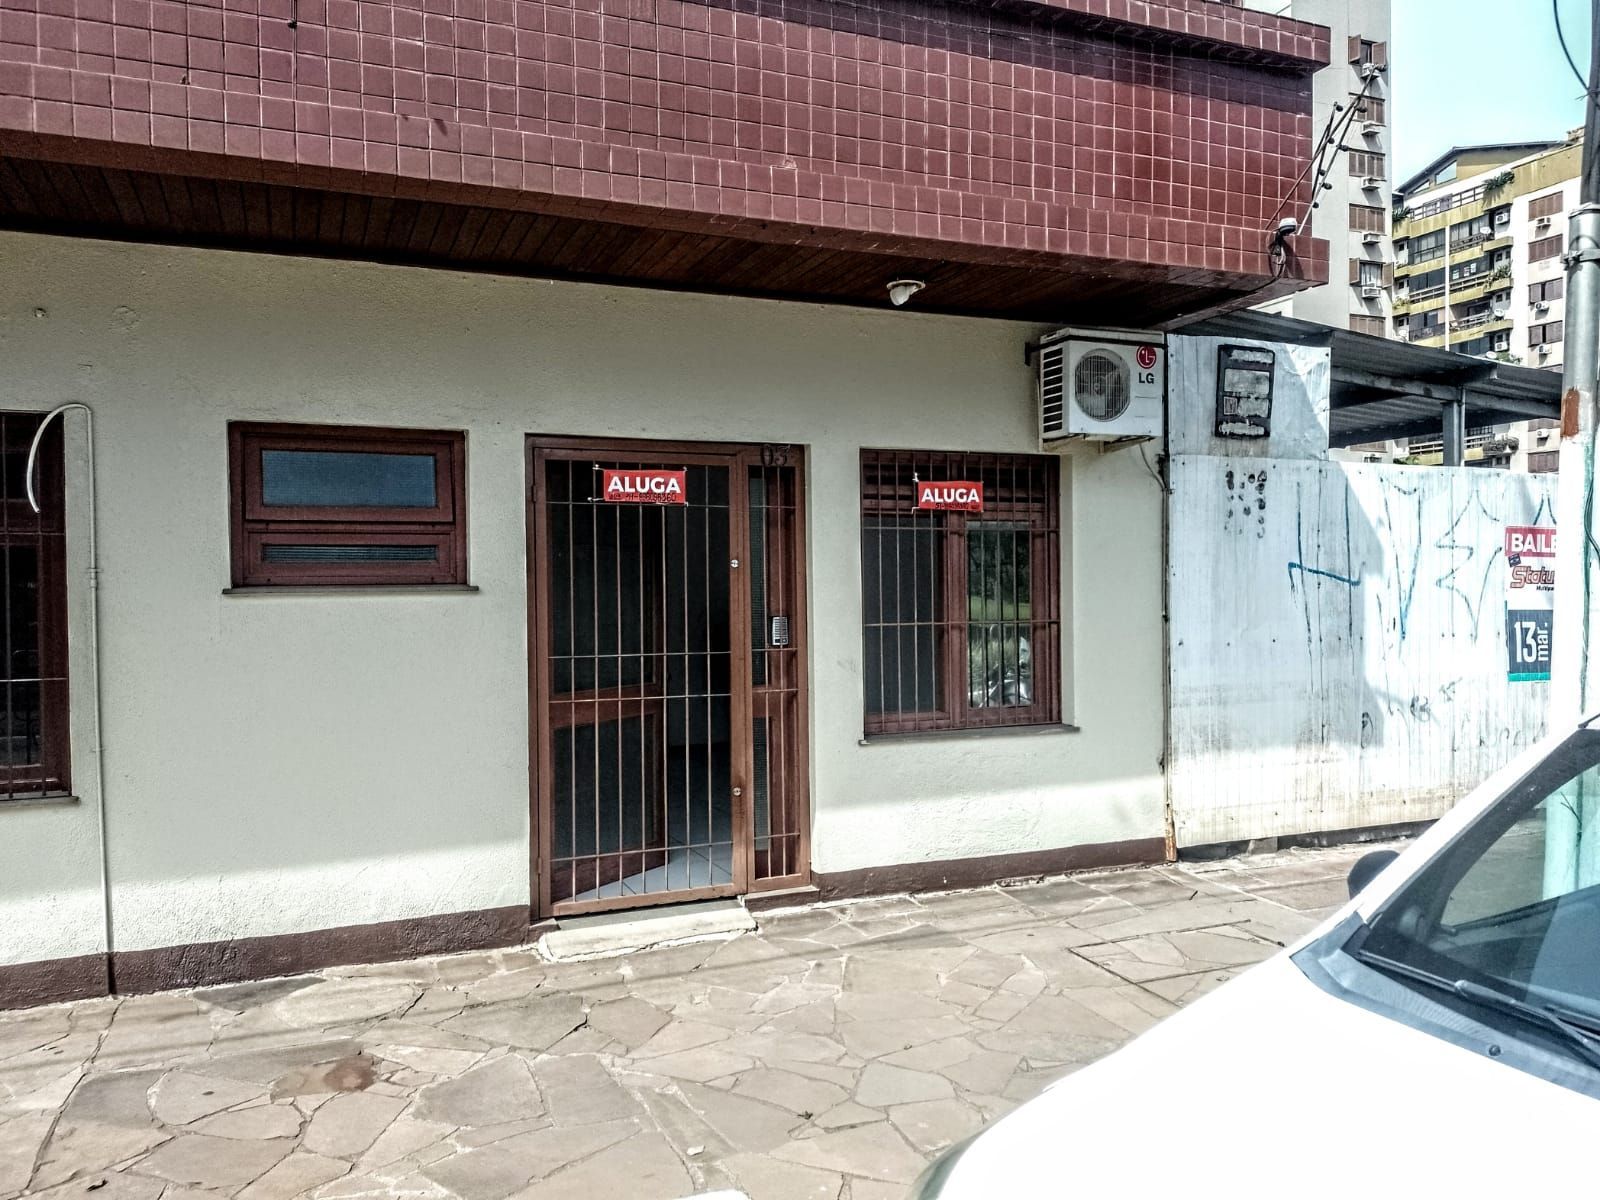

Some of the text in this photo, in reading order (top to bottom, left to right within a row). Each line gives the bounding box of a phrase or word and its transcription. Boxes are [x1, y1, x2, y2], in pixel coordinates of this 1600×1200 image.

[1138, 372, 1155, 385] LG
[607, 476, 681, 494] ALUGA
[921, 488, 980, 503] ALUGA
[1514, 621, 1537, 662] 13
